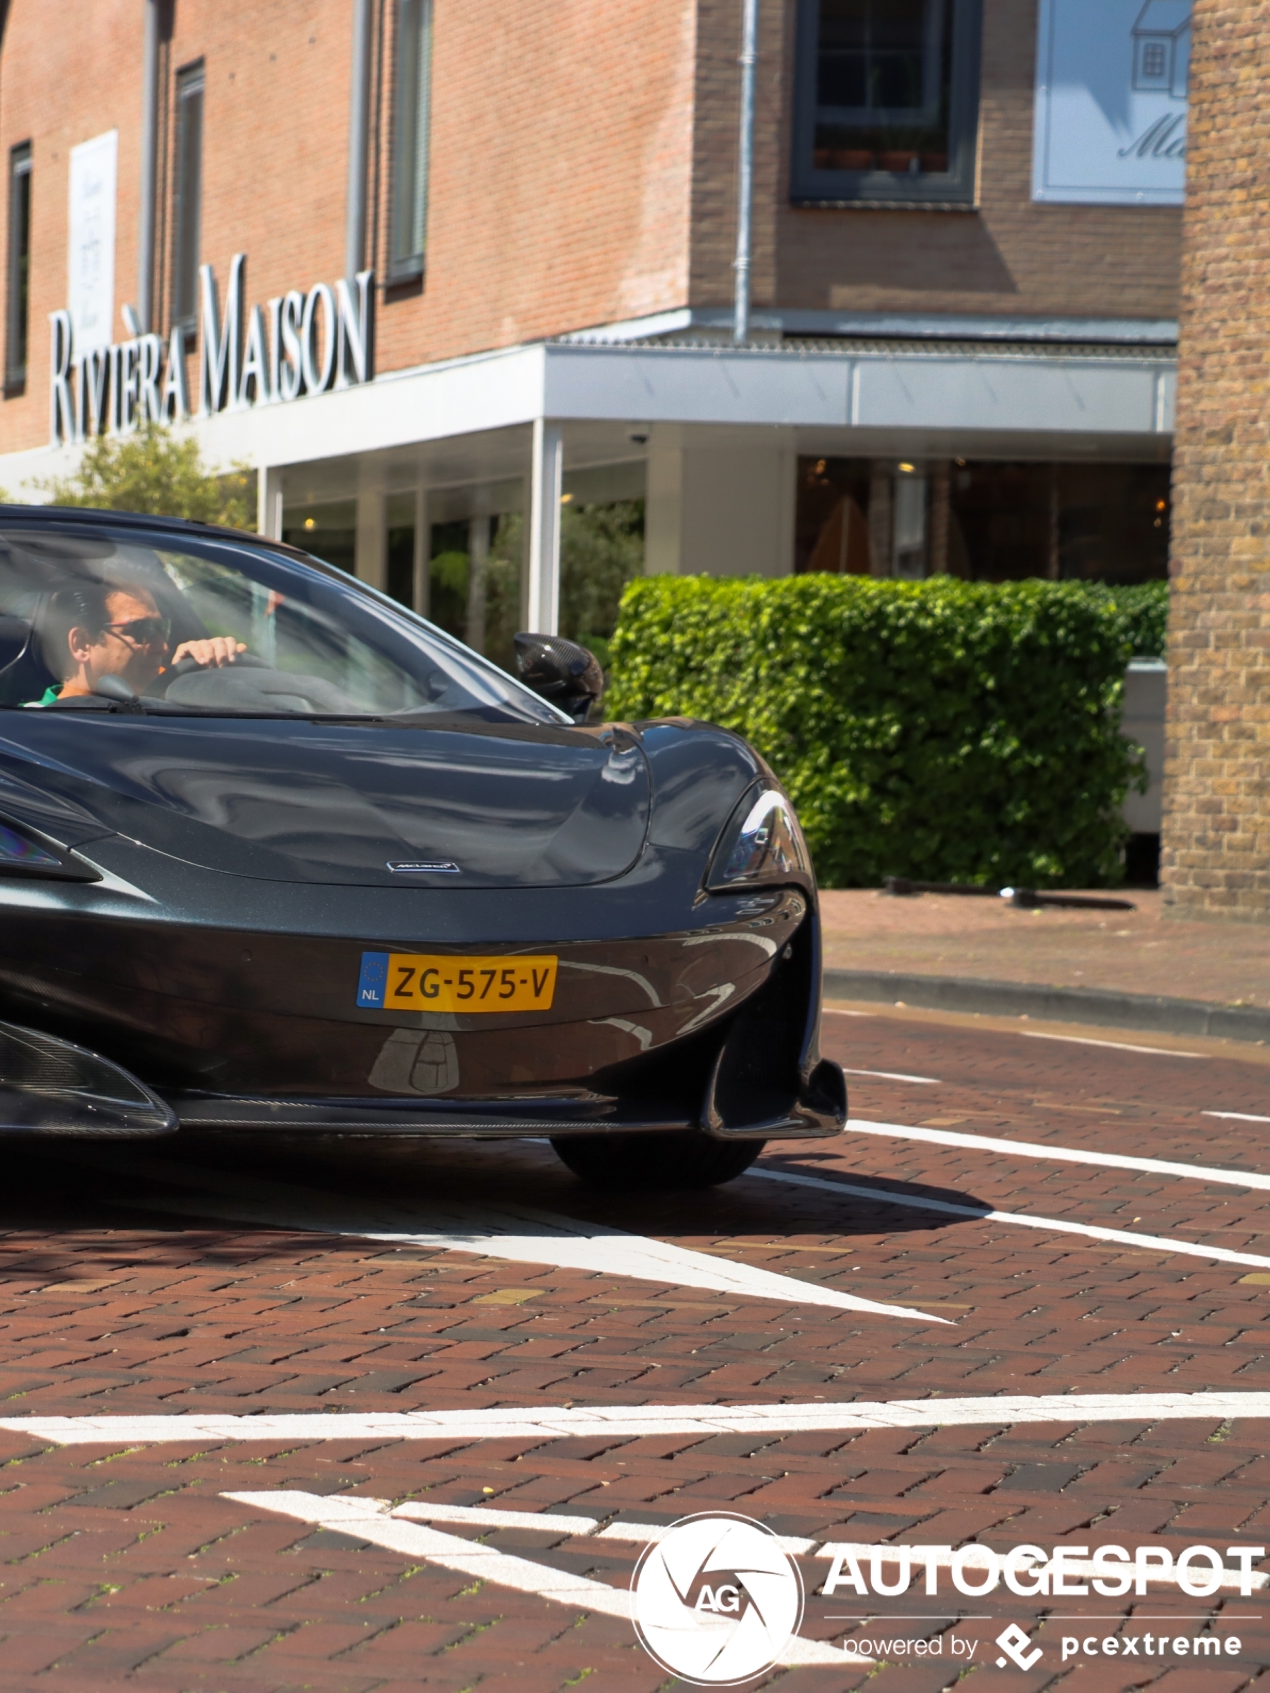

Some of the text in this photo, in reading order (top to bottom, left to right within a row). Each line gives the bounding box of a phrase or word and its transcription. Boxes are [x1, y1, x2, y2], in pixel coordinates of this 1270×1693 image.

[194, 253, 375, 421] MAISON
[362, 966, 550, 1000] NL ZG-575-V
